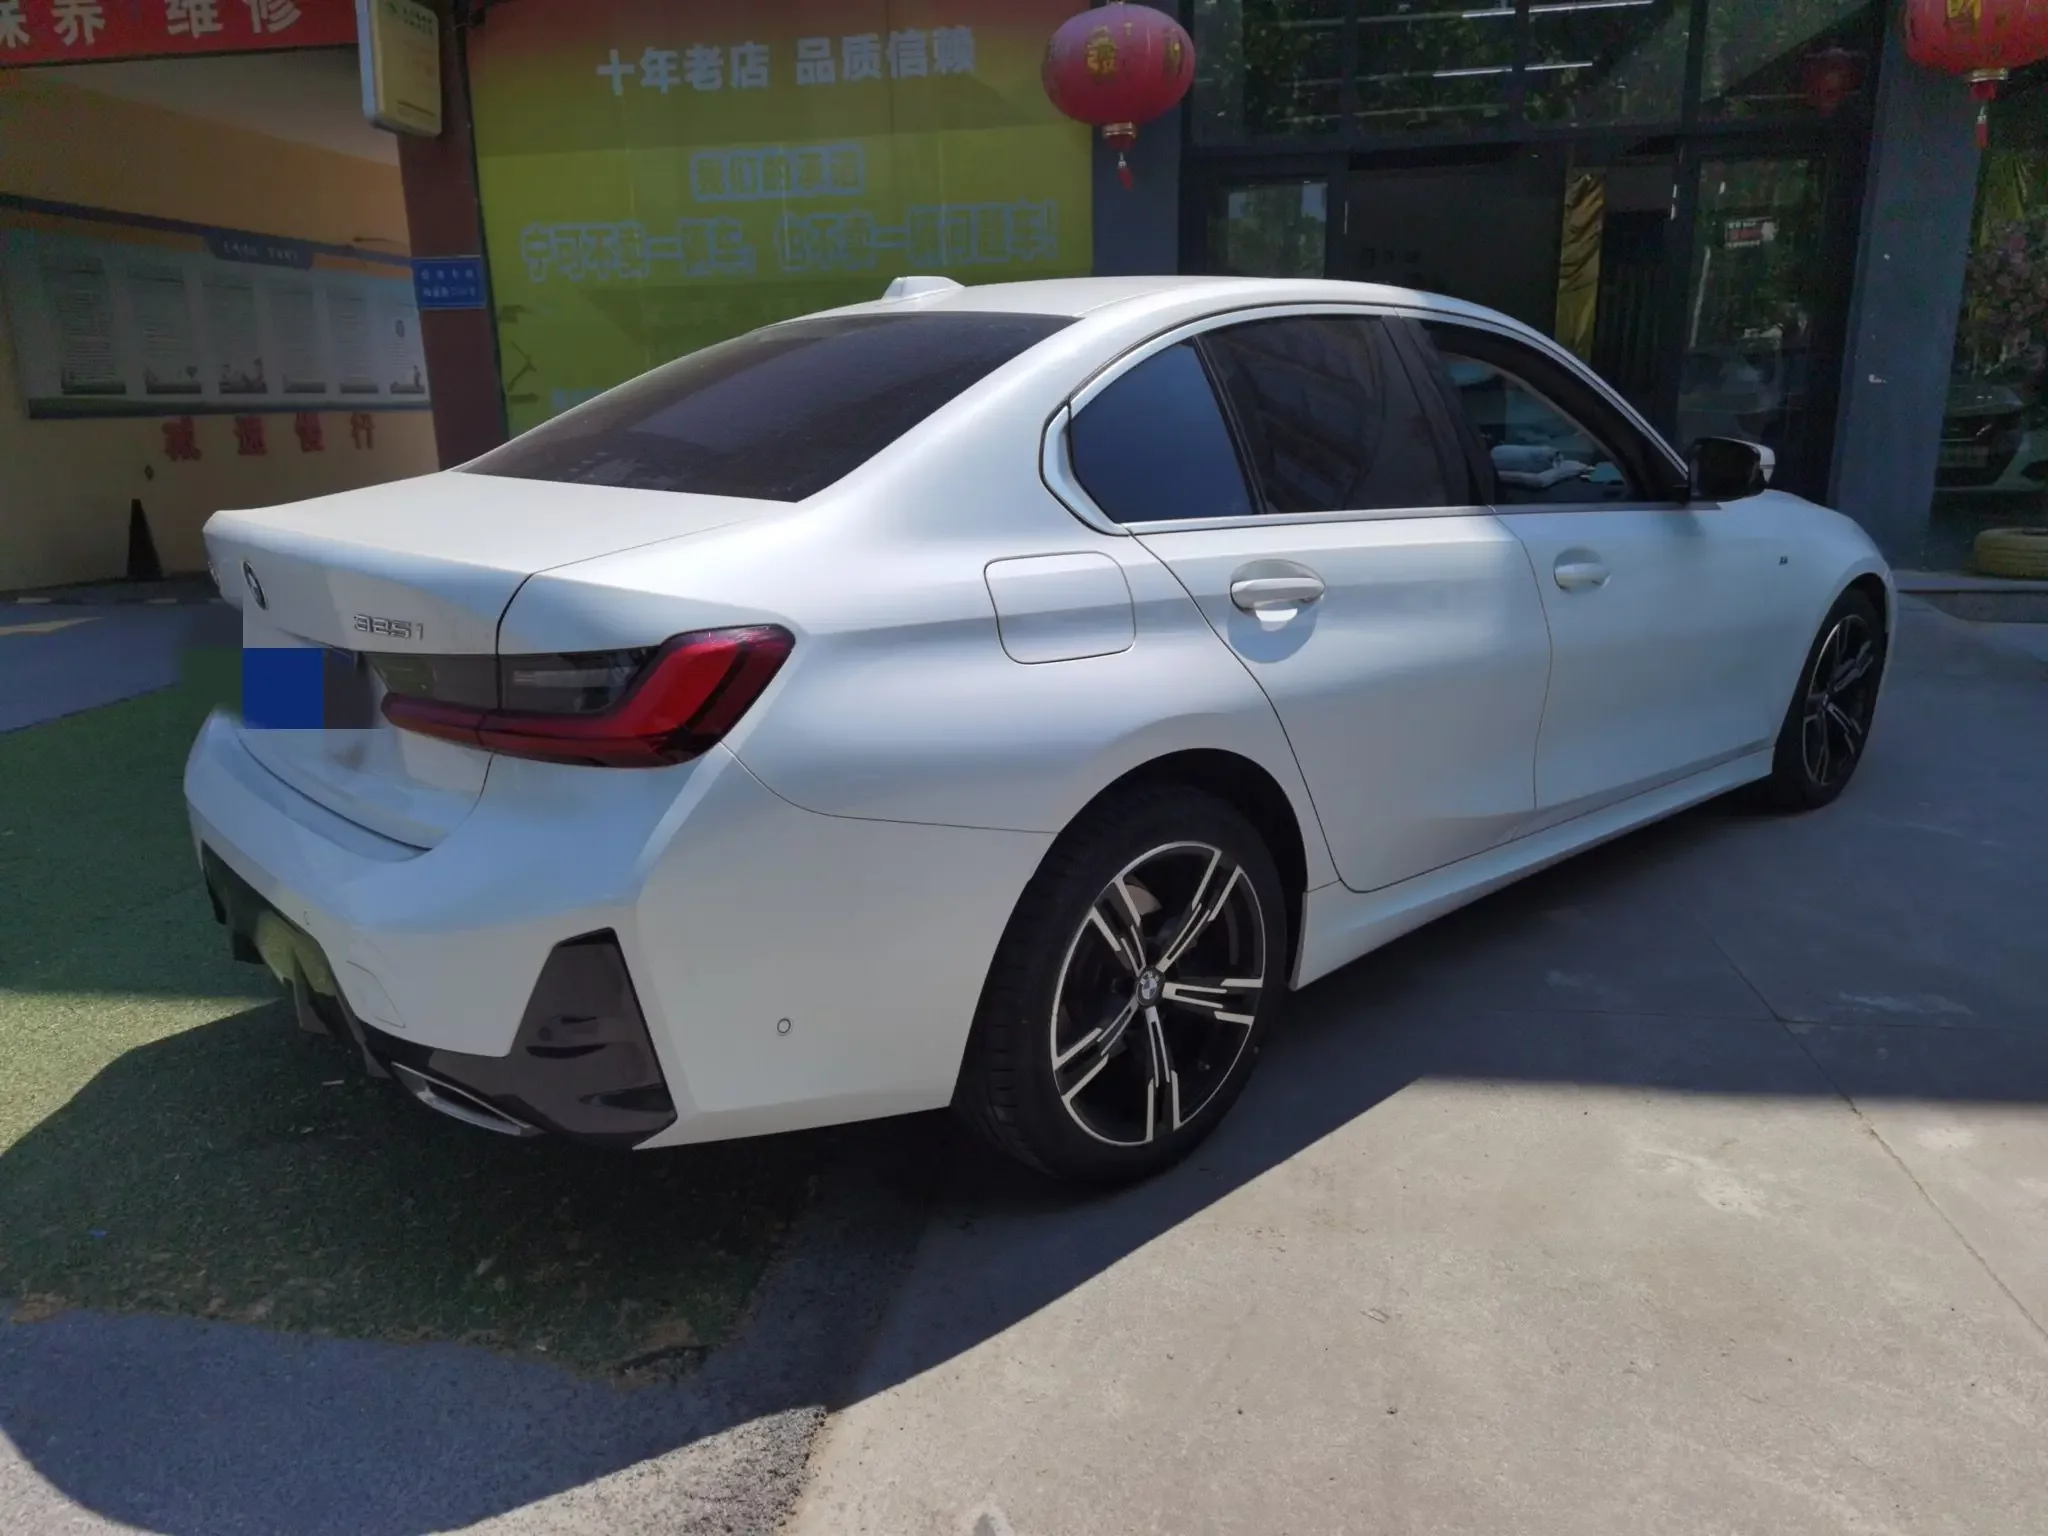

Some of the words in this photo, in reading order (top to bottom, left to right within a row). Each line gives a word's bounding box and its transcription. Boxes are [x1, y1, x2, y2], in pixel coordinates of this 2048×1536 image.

[165, 0, 302, 39] 维修
[596, 41, 770, 96] 十年老店
[795, 25, 976, 87] 品质信赖
